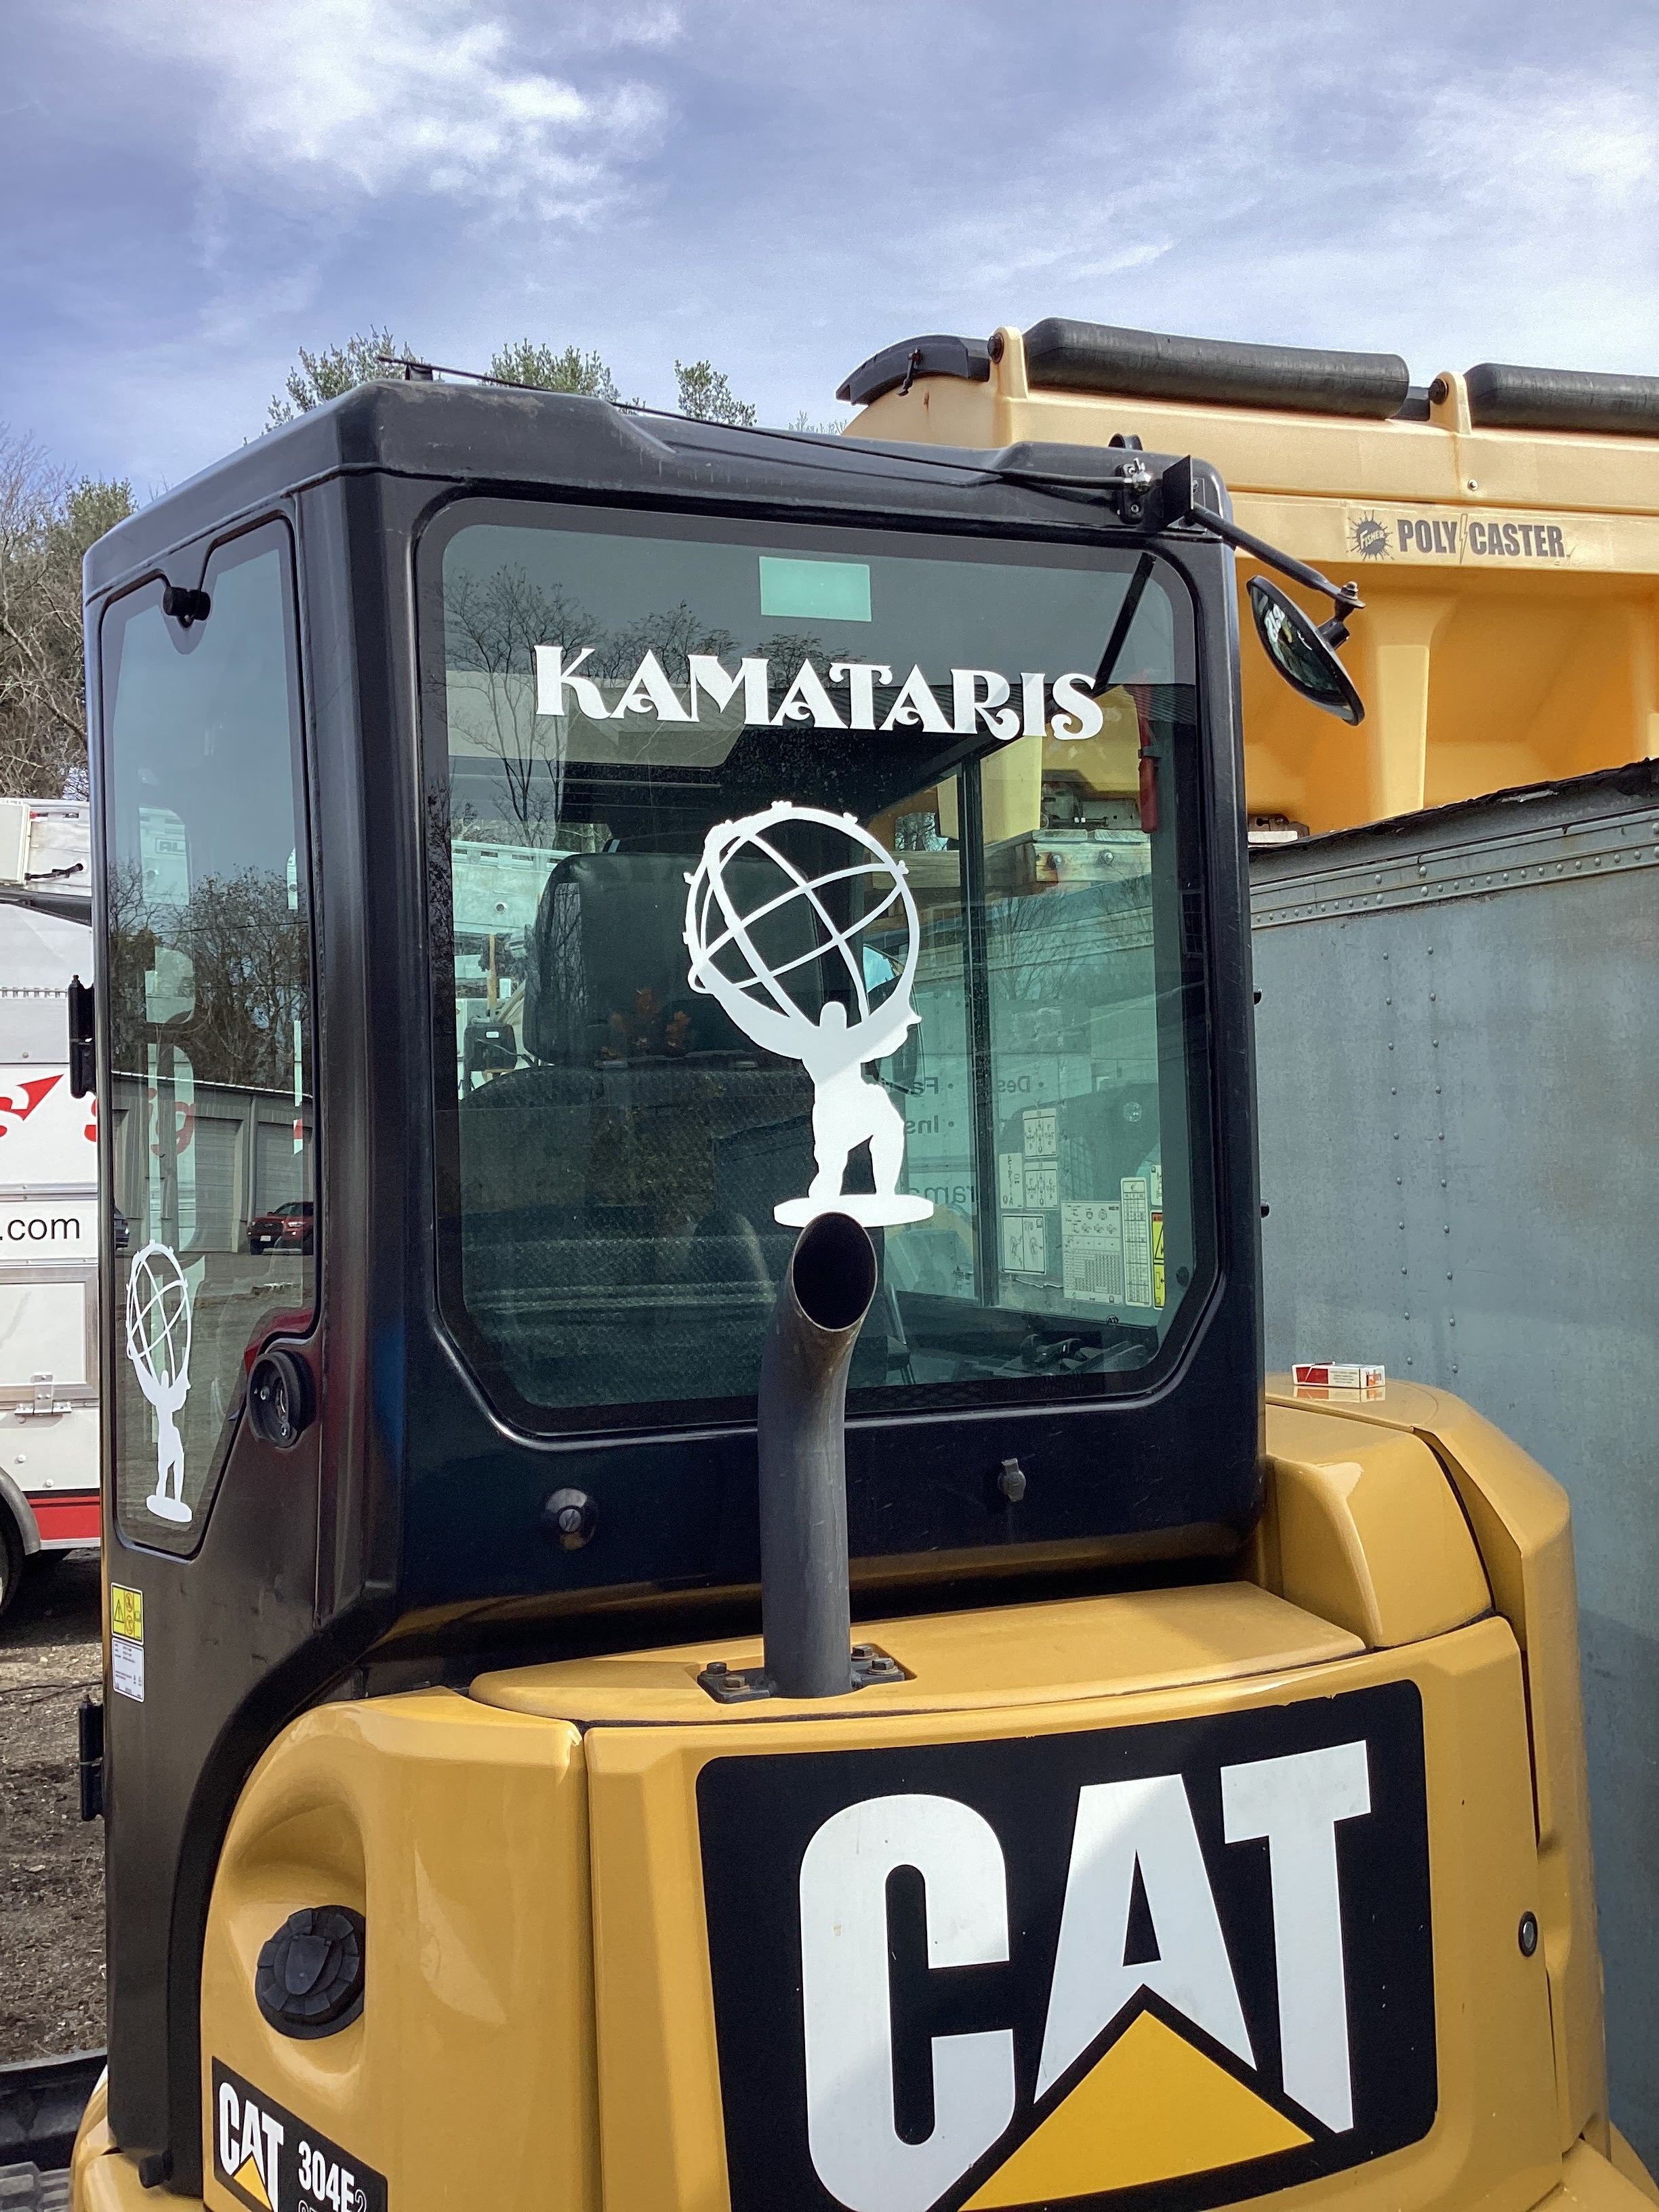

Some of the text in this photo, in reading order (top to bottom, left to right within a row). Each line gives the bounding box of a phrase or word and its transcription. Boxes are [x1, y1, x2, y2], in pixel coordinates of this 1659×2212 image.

[1359, 529, 1385, 550] FISHER
[1397, 520, 1564, 558] POLY CASTER
[533, 644, 1103, 740] KAMATARIS
[799, 1740, 1371, 2212] CAT
[219, 2082, 284, 2212] CAT
